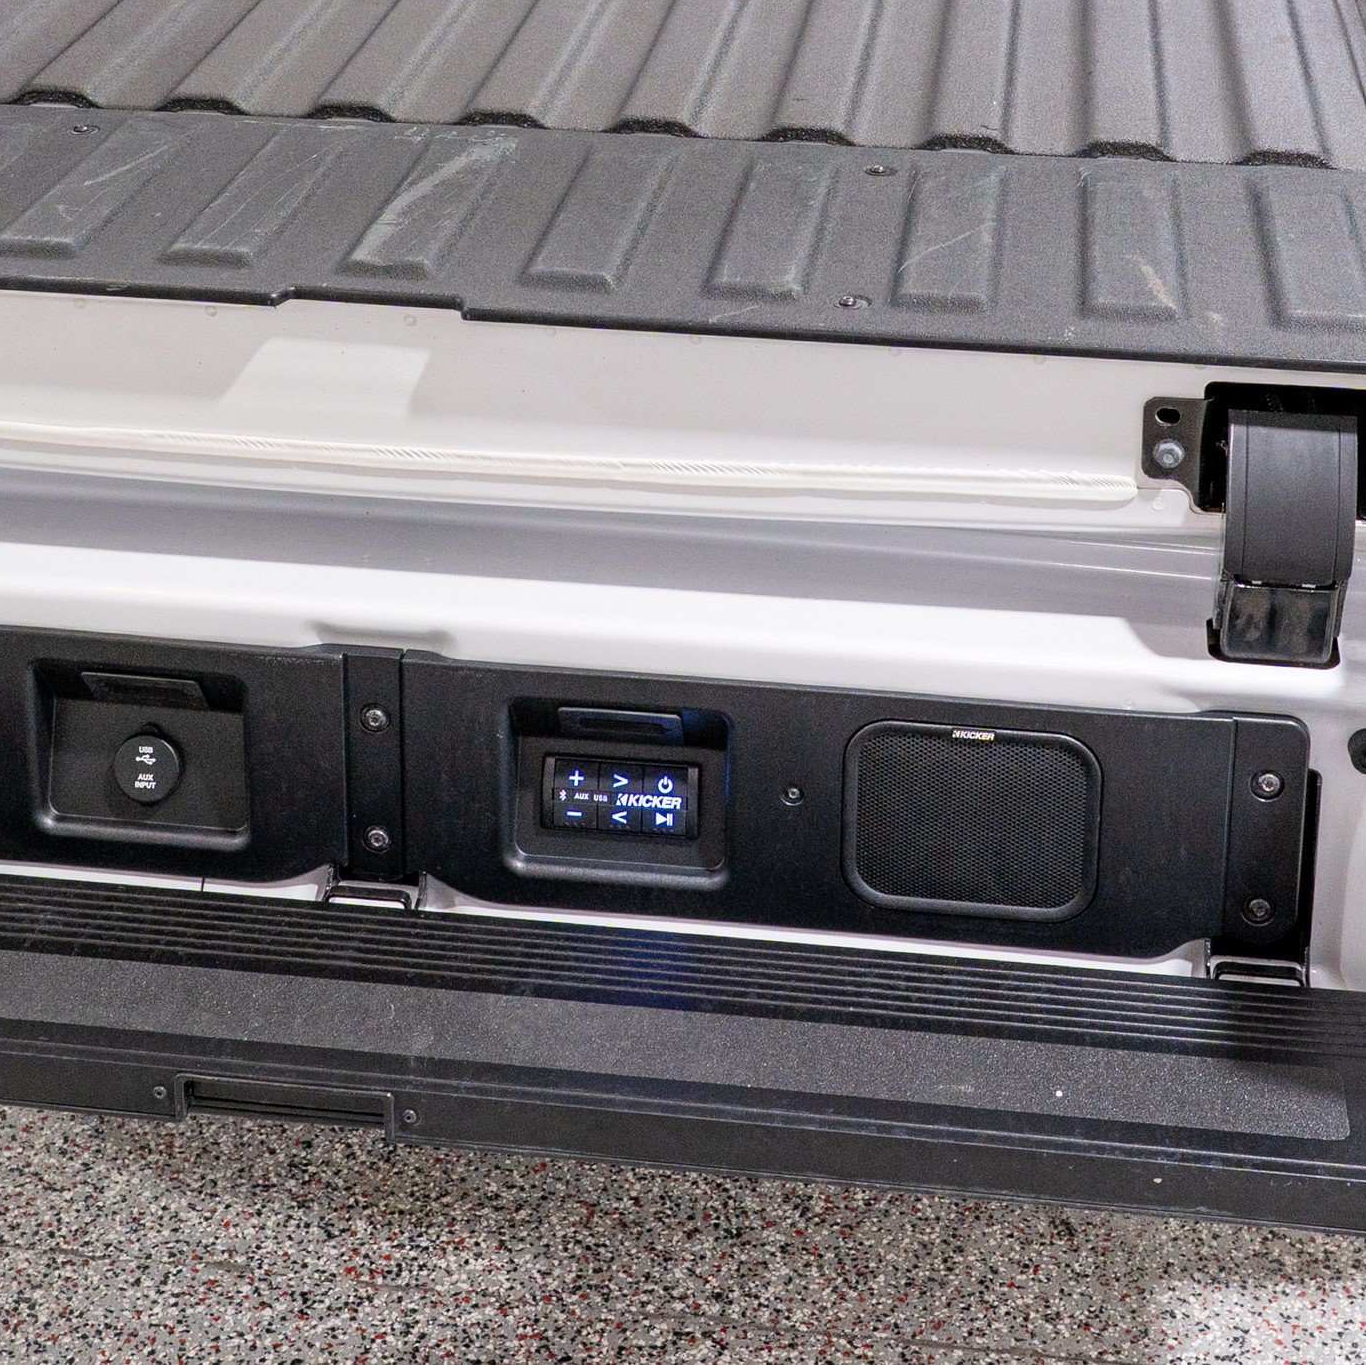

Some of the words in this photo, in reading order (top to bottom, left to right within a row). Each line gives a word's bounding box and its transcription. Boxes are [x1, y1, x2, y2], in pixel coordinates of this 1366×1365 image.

[960, 730, 995, 741] KICKER
[138, 746, 154, 754] USB
[137, 773, 154, 781] AUX
[134, 781, 156, 789] INPUT
[574, 792, 590, 801] AUX
[593, 794, 608, 802] USB
[627, 794, 682, 809] KICKER
